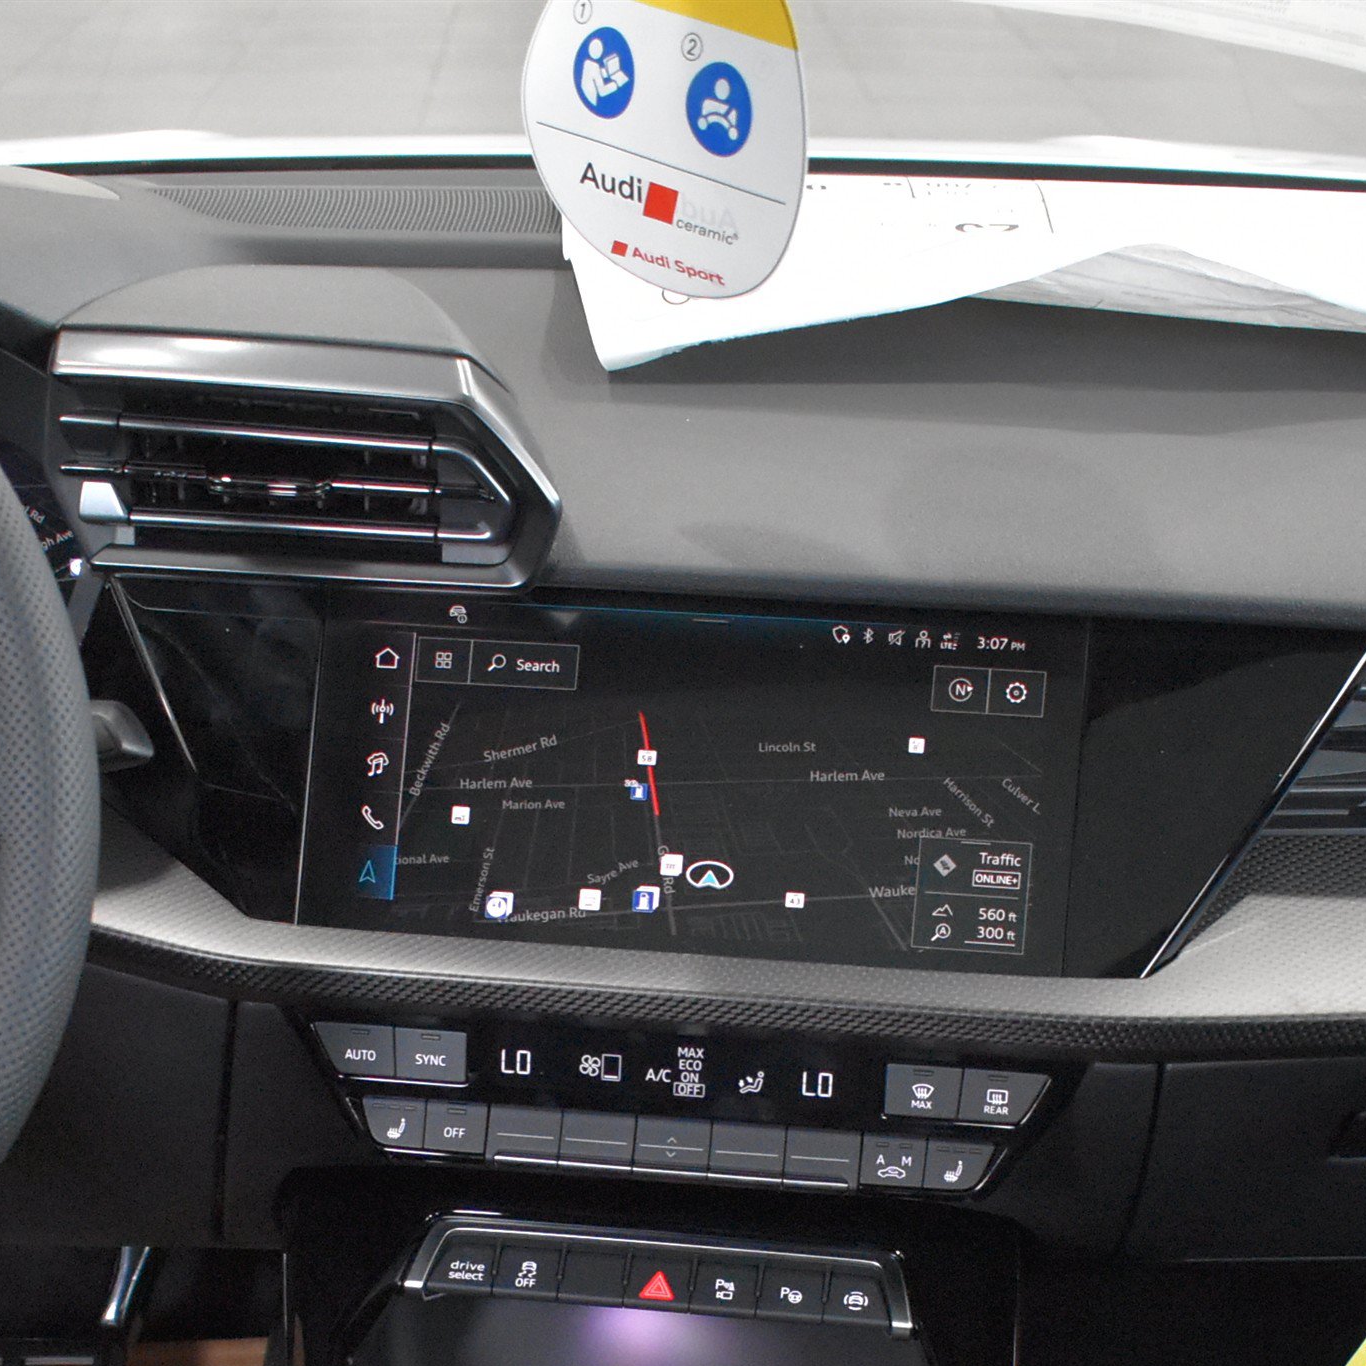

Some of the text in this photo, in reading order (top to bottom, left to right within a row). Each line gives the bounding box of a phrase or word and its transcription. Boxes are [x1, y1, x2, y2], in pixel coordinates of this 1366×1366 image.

[687, 39, 697, 56] 2
[579, 162, 643, 204] Audi
[632, 247, 725, 286] Audi Sport
[977, 637, 1025, 651] 3:07 PM
[517, 659, 560, 673] Search
[483, 735, 558, 762] Shermer Rd
[759, 742, 816, 753] Lincoln St
[409, 722, 450, 797] Beckwith Rd
[810, 770, 885, 782] Harlem Ave
[460, 778, 533, 790] Harlem Ave
[1002, 778, 1034, 807] Culver
[502, 800, 565, 810] Marion Ave
[943, 778, 995, 828] Harrison St
[889, 806, 942, 818] Neva Ave
[897, 827, 967, 839] Nordica Ave
[429, 854, 450, 864] Ave
[979, 852, 1021, 867] Traffic
[587, 859, 639, 885] Sayre Ave
[469, 847, 495, 912] Emerson St
[663, 876, 675, 894] Rd
[975, 874, 1018, 885] ONLINE+
[869, 886, 915, 898] Wauke
[498, 907, 567, 923] aukegan
[978, 908, 1017, 922] 560 ft
[977, 927, 1015, 941] 300 ft
[345, 1048, 377, 1061] AUTO
[677, 1047, 705, 1059] MAX
[415, 1054, 447, 1067] SYNC
[501, 1049, 531, 1075] LO
[679, 1059, 702, 1071] ECO
[645, 1068, 671, 1083] A/C
[680, 1072, 699, 1082] ON
[677, 1084, 702, 1096] OFF
[802, 1071, 833, 1098] LO
[911, 1099, 932, 1109] MAX
[983, 1105, 1009, 1115] REAR
[443, 1127, 465, 1138] OFF
[876, 1154, 885, 1165] A
[901, 1156, 912, 1166] M
[450, 1260, 485, 1273] drive
[448, 1269, 484, 1281] select
[515, 1278, 536, 1288] OFF
